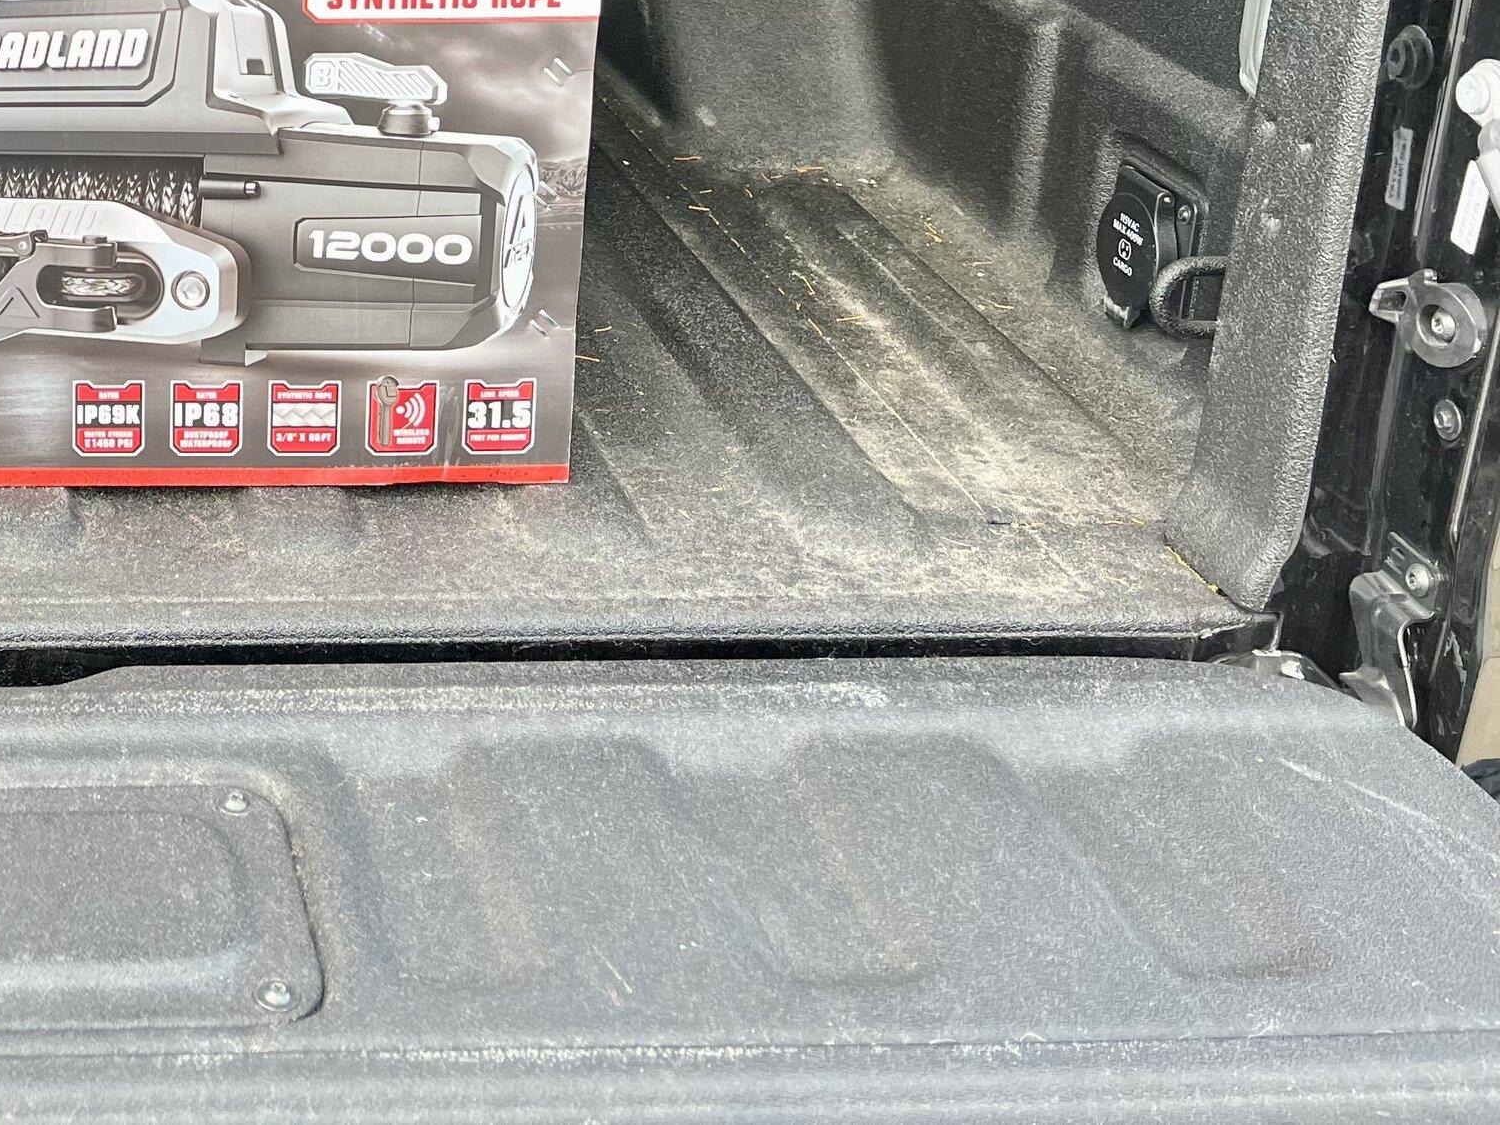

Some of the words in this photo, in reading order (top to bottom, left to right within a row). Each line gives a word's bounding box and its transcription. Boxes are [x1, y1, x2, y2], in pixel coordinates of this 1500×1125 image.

[1112, 218, 1128, 235] MAX
[308, 228, 473, 266] 12000
[1112, 256, 1133, 277] CARGO
[76, 404, 141, 425] IP69K
[174, 402, 239, 427] IP68
[467, 400, 532, 429] 31.5
[393, 428, 430, 437] WIRELESS
